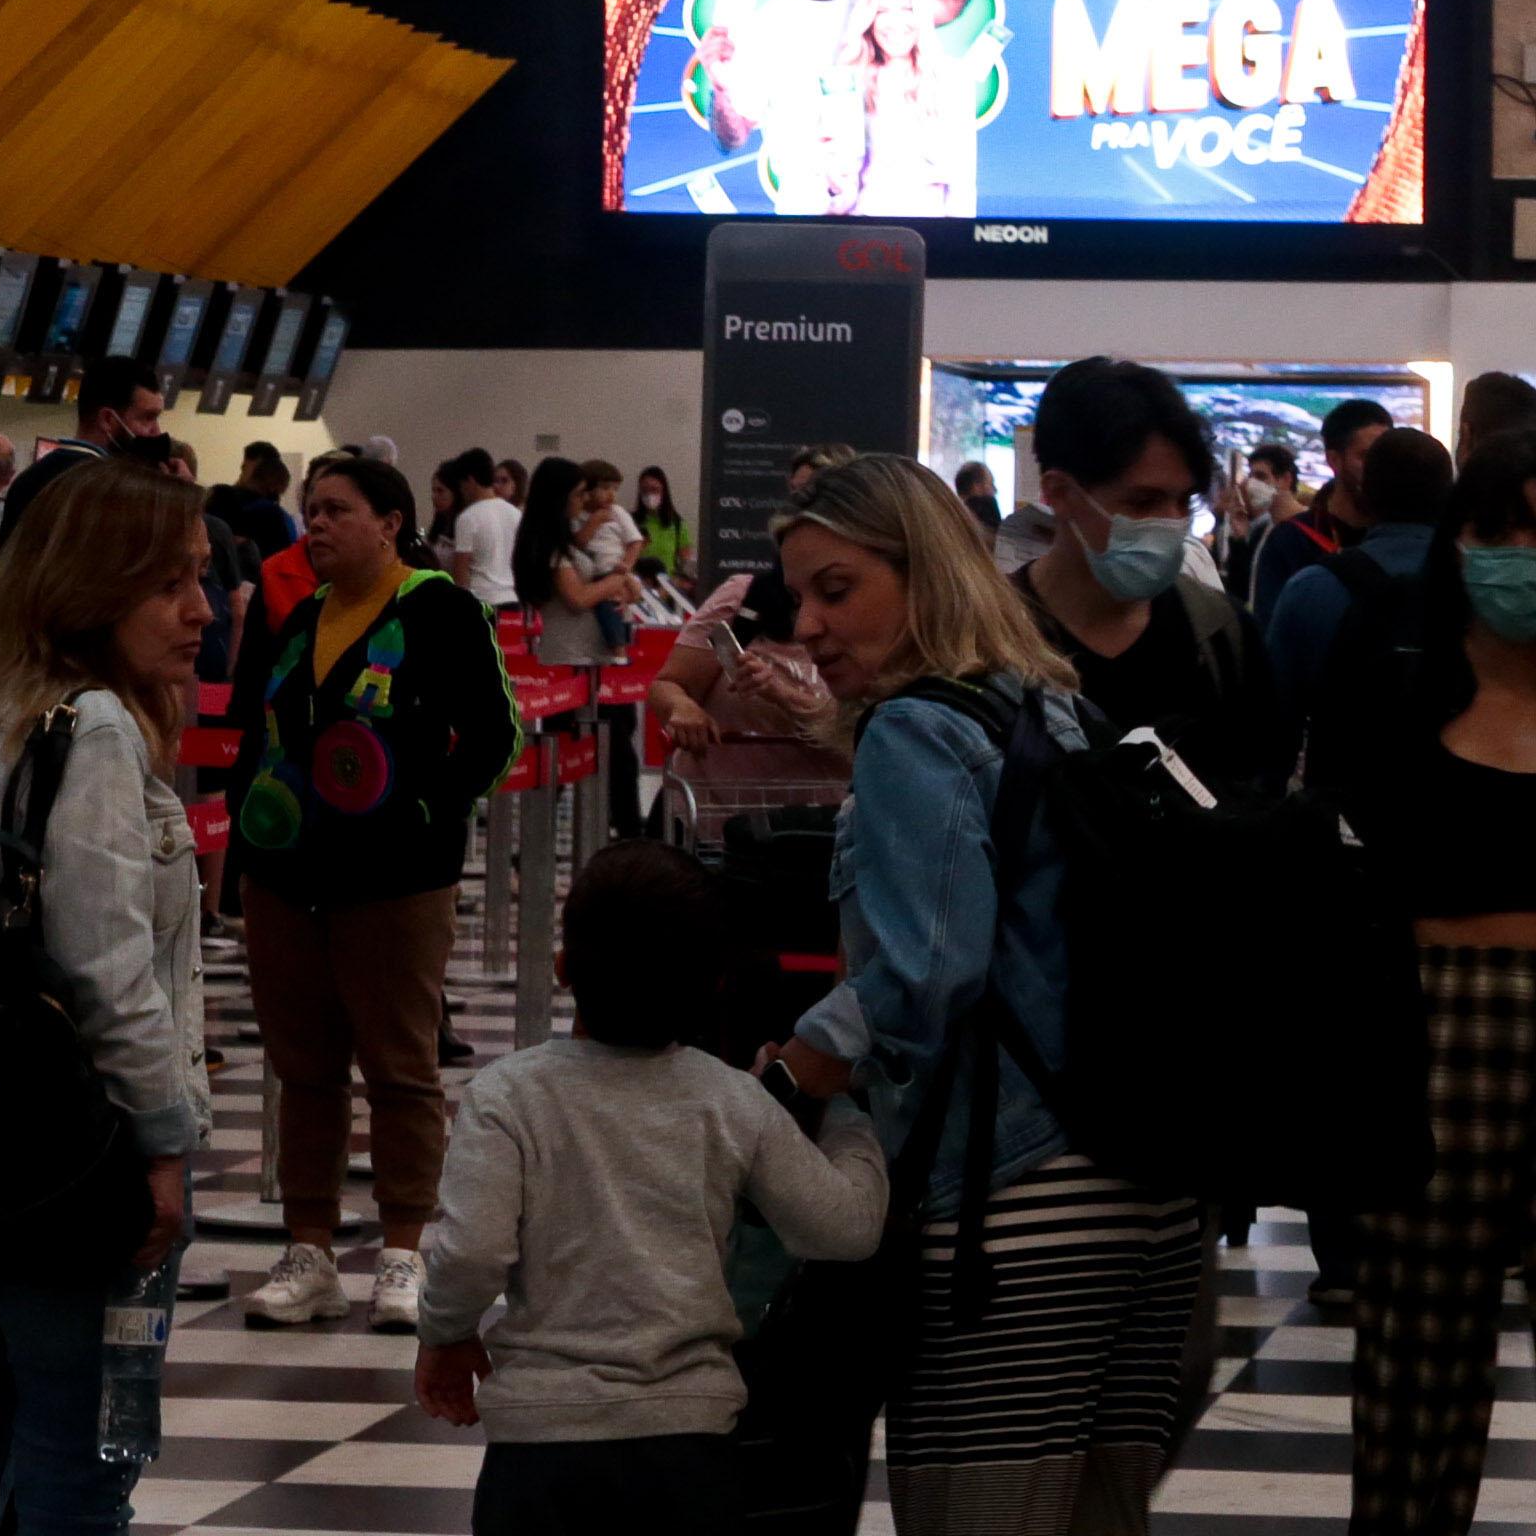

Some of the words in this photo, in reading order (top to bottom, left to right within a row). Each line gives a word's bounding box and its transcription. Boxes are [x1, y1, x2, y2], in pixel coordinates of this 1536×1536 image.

[1091, 121, 1150, 150] PRA
[1151, 103, 1307, 169] VOCÊ
[836, 239, 912, 273] GOL
[724, 315, 852, 343] Premium
